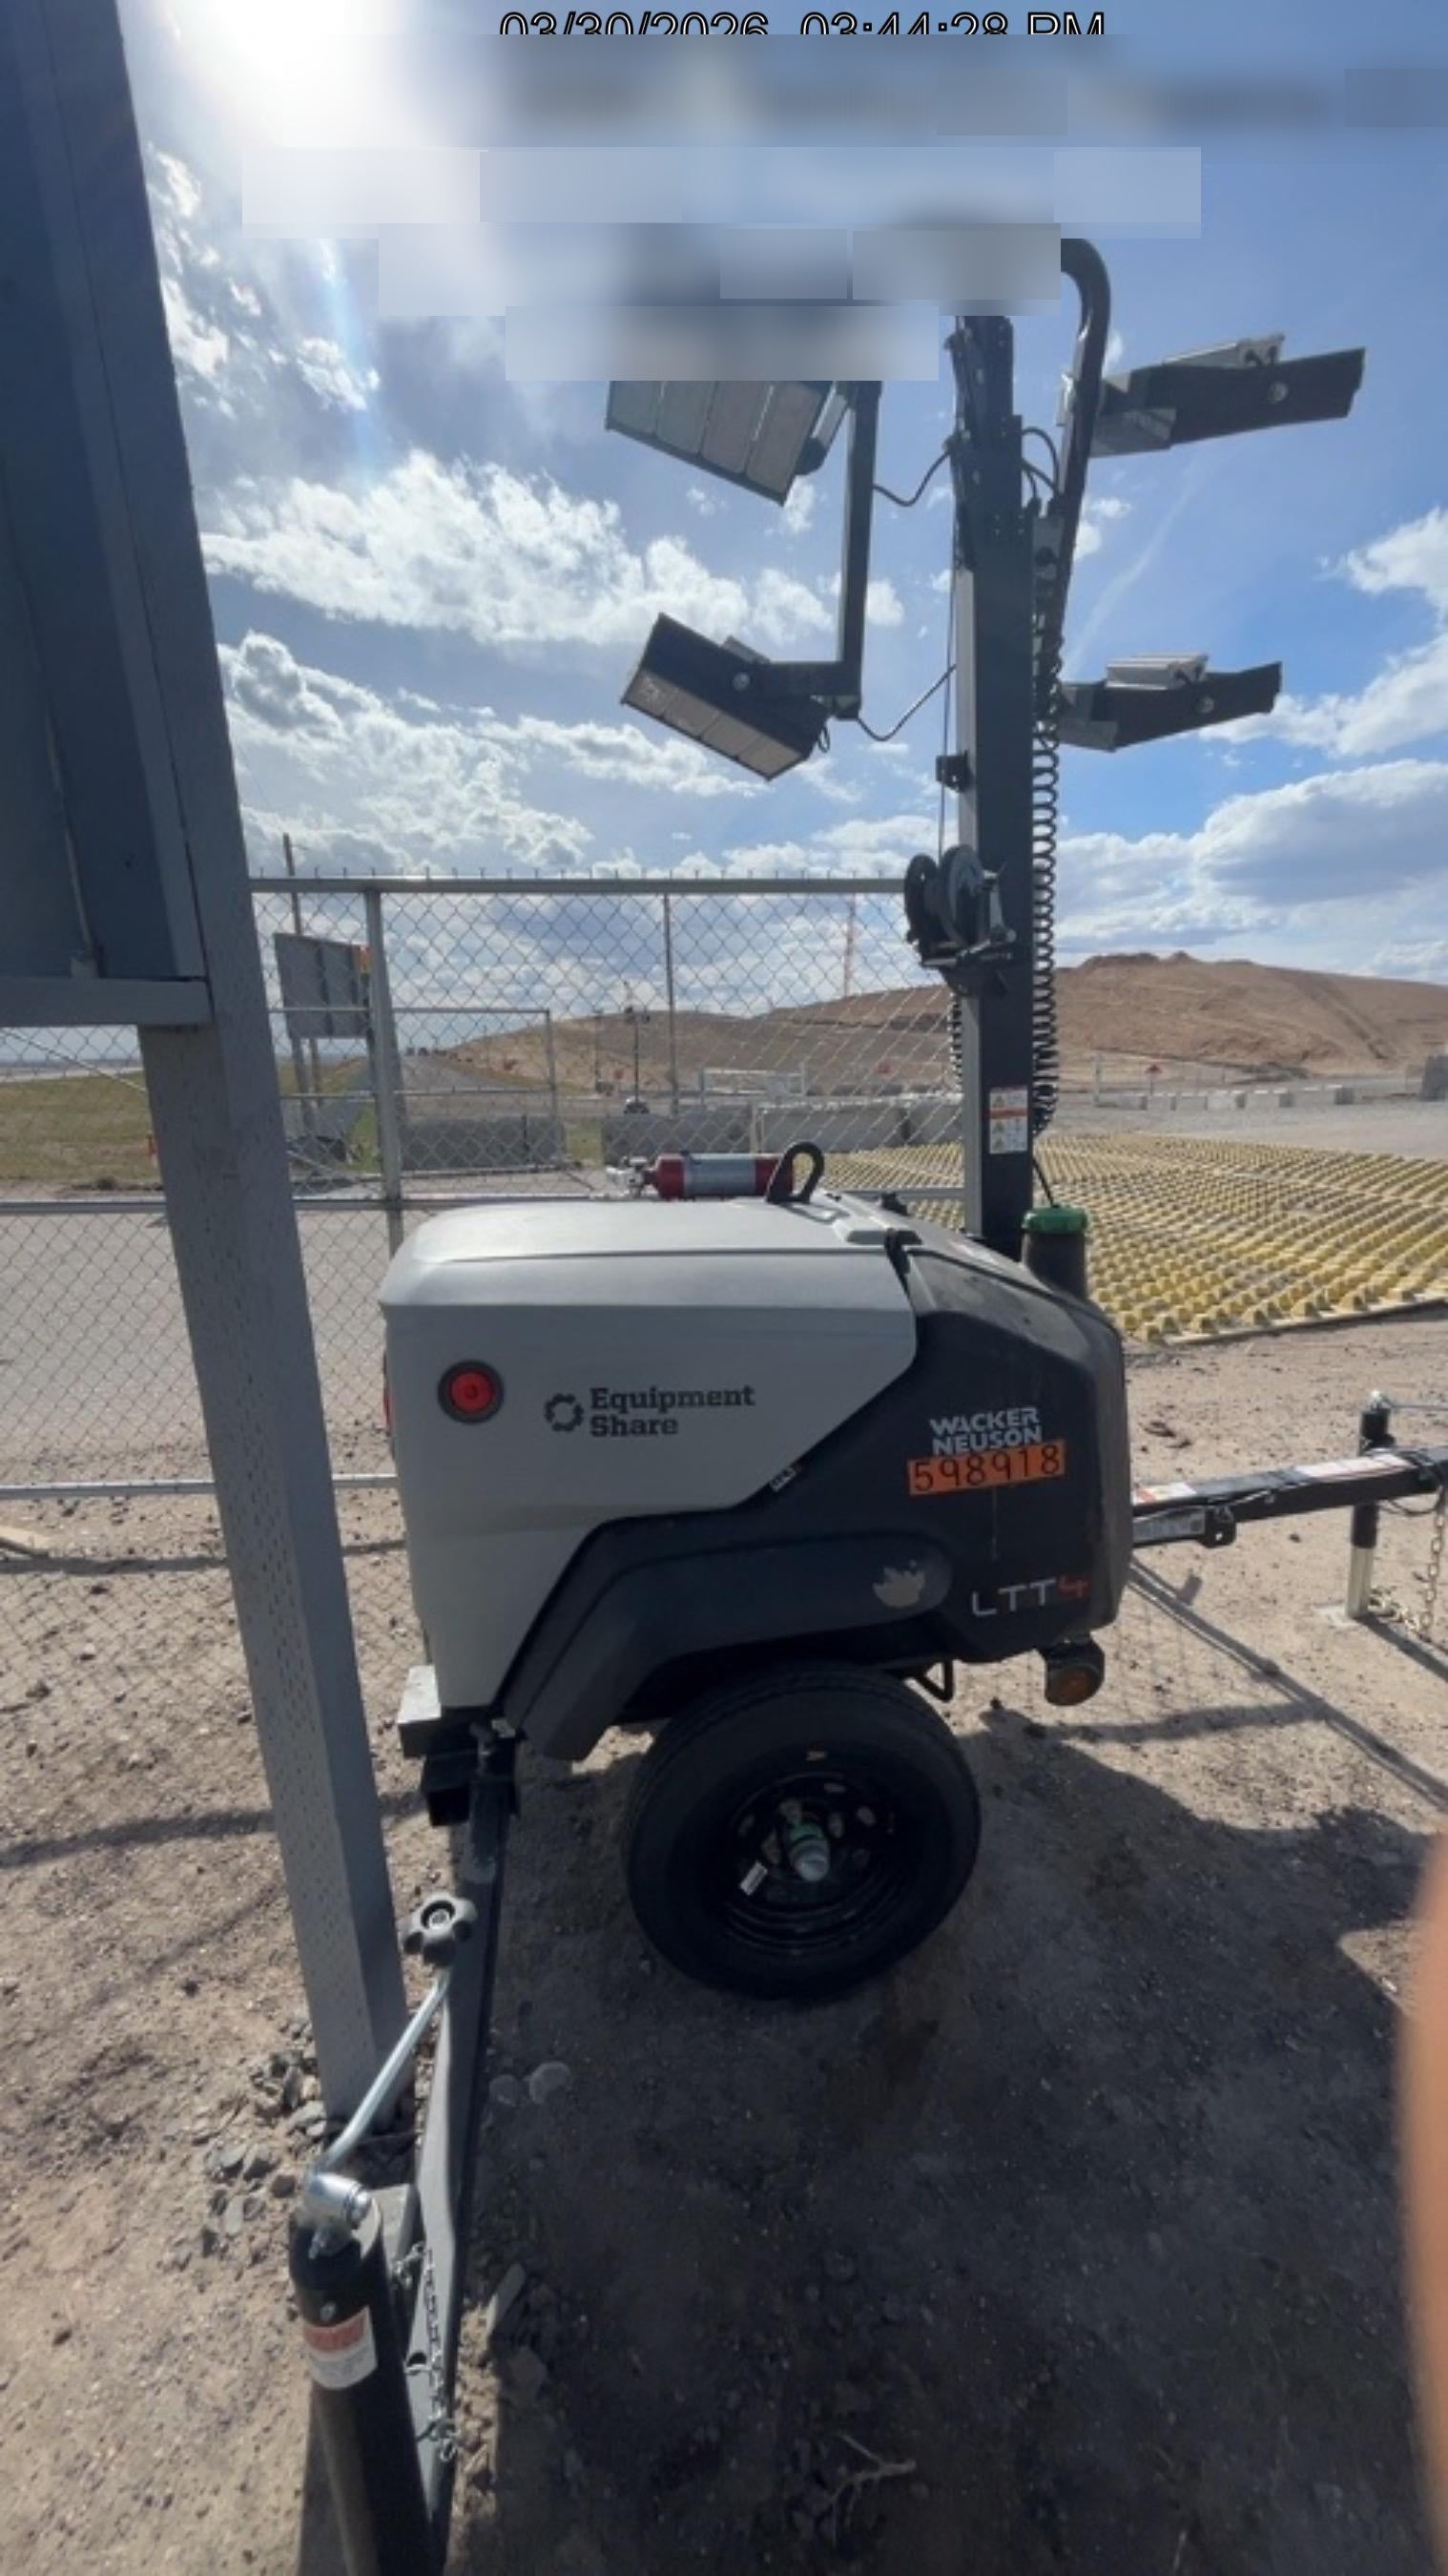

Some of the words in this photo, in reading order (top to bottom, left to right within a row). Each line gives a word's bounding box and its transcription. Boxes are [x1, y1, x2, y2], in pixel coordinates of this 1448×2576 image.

[590, 1385, 756, 1414] Equipment
[590, 1415, 679, 1438] Share
[929, 1406, 1040, 1436] WACKER
[932, 1425, 1042, 1456] NEUSON
[914, 1444, 1060, 1491] 598918
[972, 1575, 1089, 1616] LTT4
